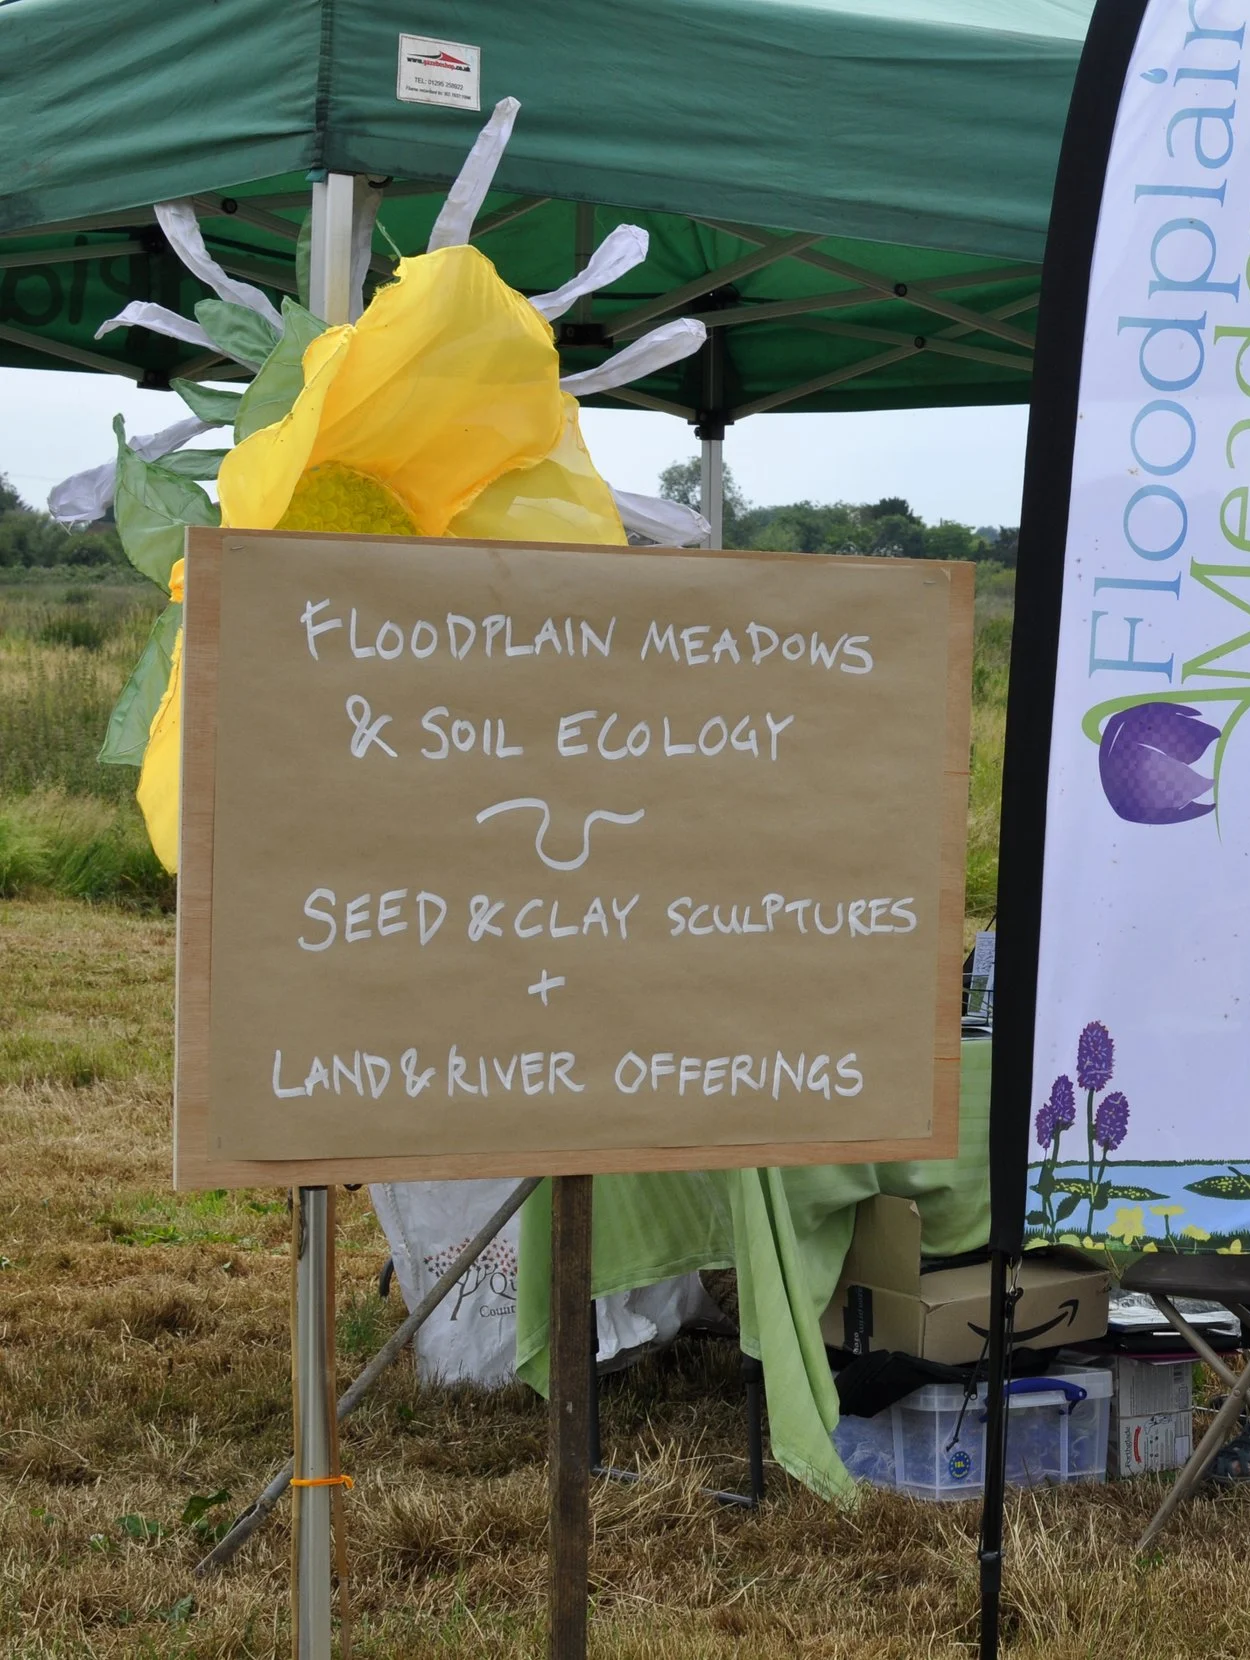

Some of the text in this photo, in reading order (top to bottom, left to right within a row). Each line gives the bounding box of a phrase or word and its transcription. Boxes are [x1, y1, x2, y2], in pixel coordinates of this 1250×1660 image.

[414, 77, 427, 85] TEL:
[300, 598, 875, 675] FLOODPLAIN MEADOWS
[345, 694, 796, 761] & SOIL ECOLOGY
[297, 887, 448, 951] SEED
[667, 893, 918, 938] SCULPTURES
[527, 969, 566, 1006] +
[614, 1050, 865, 1101] OFFERINGS
